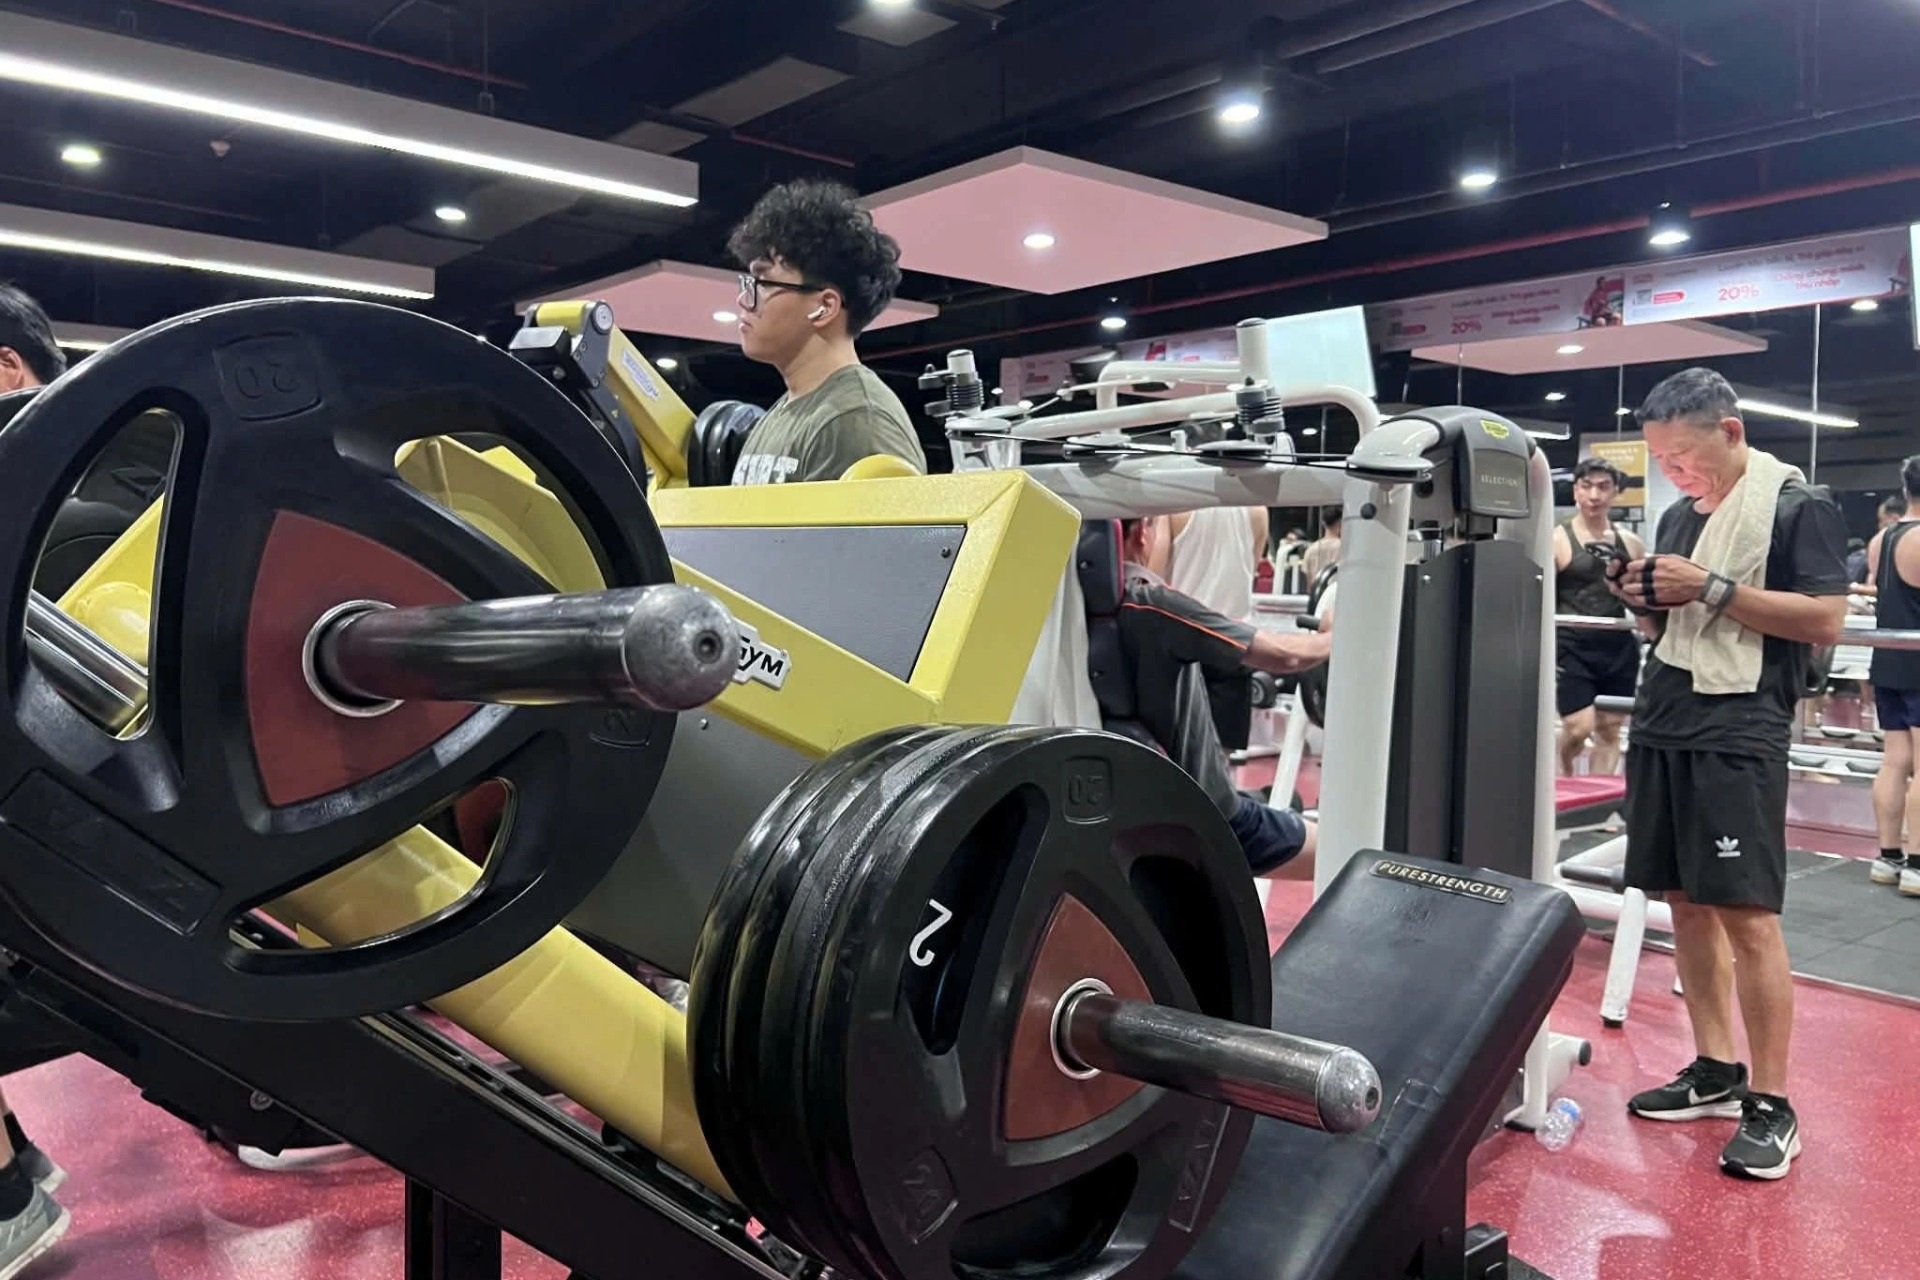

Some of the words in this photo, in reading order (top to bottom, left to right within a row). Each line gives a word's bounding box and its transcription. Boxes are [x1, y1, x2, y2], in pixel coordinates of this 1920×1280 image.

[1718, 285, 1759, 301] 20%
[1378, 862, 1508, 899] PURESTRENGTH
[909, 898, 953, 967] 2
